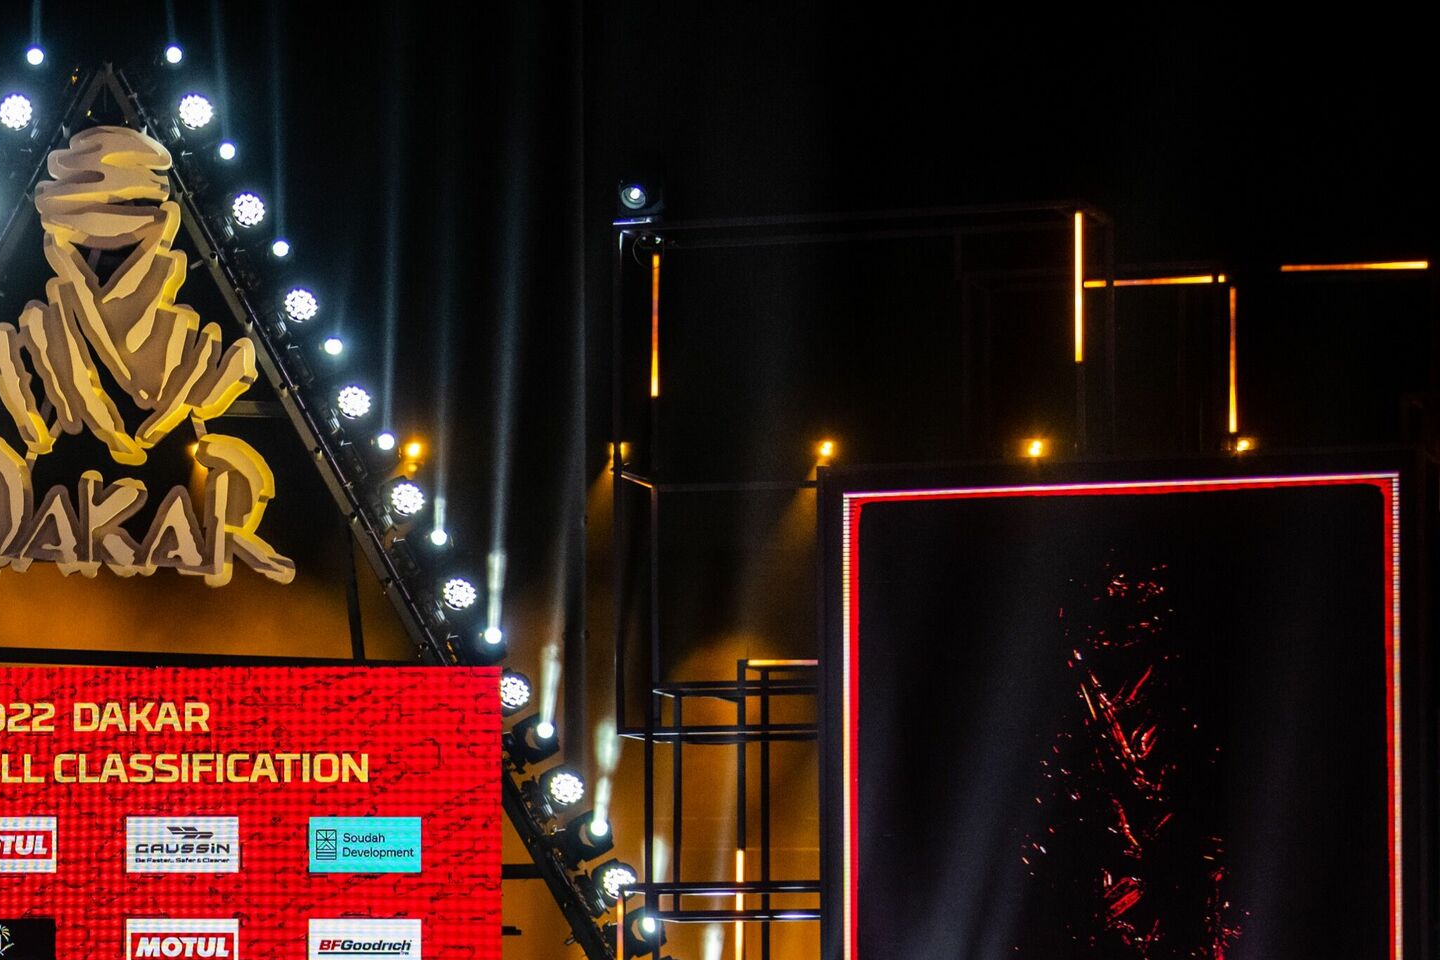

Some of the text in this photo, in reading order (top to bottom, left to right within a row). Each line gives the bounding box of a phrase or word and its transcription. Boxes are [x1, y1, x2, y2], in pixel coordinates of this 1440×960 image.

[74, 702, 210, 732] DAKAR
[53, 754, 370, 784] CLASSIFICATION
[343, 833, 385, 843] Soudah
[343, 847, 414, 859] Development
[135, 937, 230, 957] MOTUL
[319, 939, 411, 951] BFGoodrich
